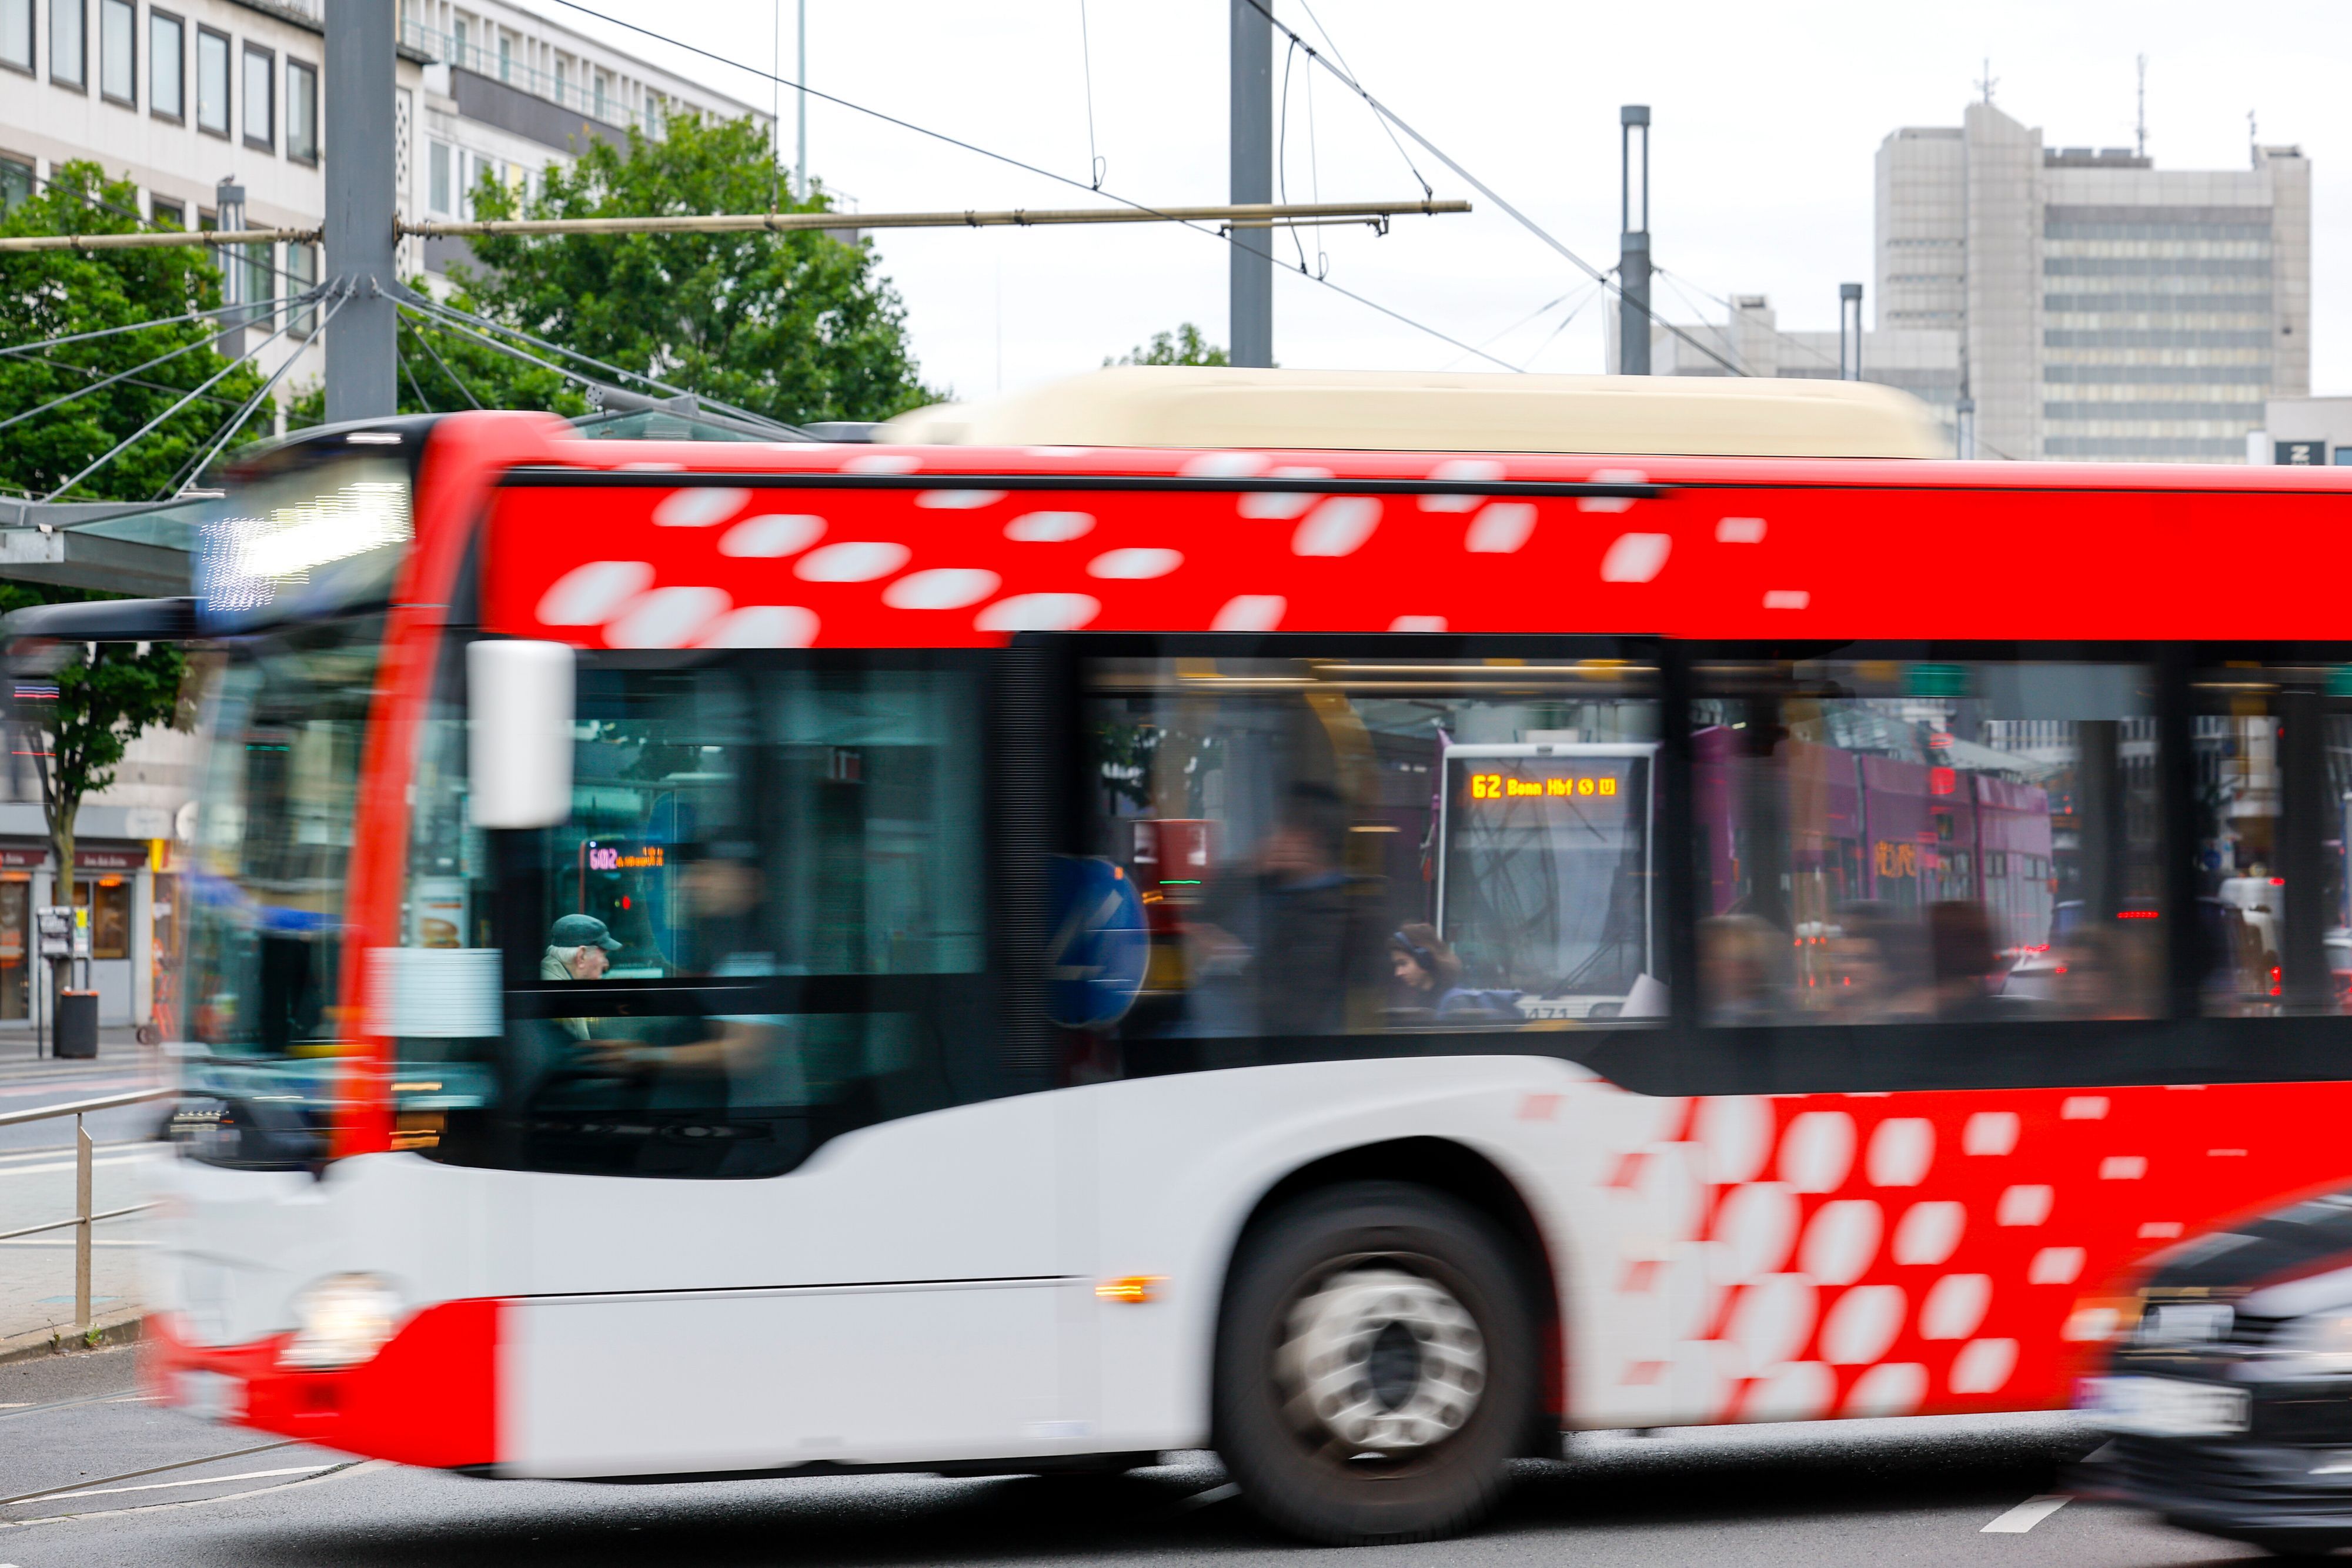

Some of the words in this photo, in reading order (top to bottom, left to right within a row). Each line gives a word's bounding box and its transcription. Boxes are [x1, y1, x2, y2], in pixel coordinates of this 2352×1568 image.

[1472, 774, 1502, 799] 62
[1506, 778, 1543, 796] Bonn
[1547, 778, 1574, 796] Hbf
[590, 848, 617, 870] 602
